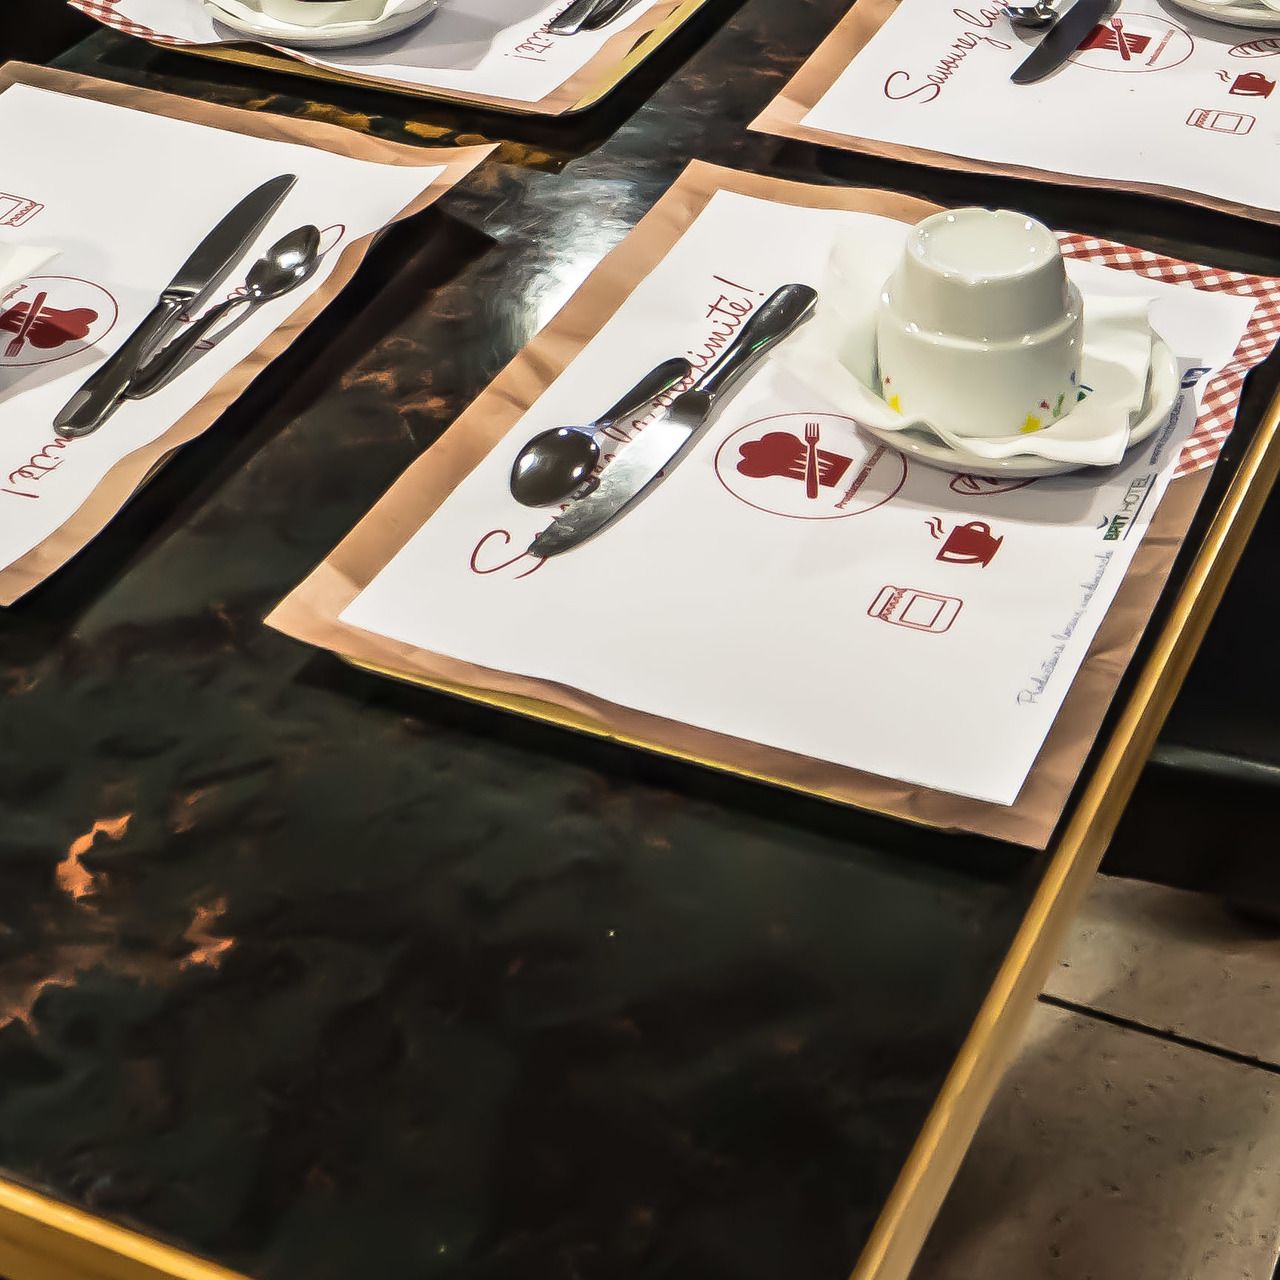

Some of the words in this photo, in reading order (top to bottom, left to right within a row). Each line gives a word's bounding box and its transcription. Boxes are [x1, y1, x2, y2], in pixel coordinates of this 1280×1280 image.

[884, 32, 1012, 104] Savourez
[952, 8, 1000, 28] la
[1121, 473, 1152, 512] HOTEL
